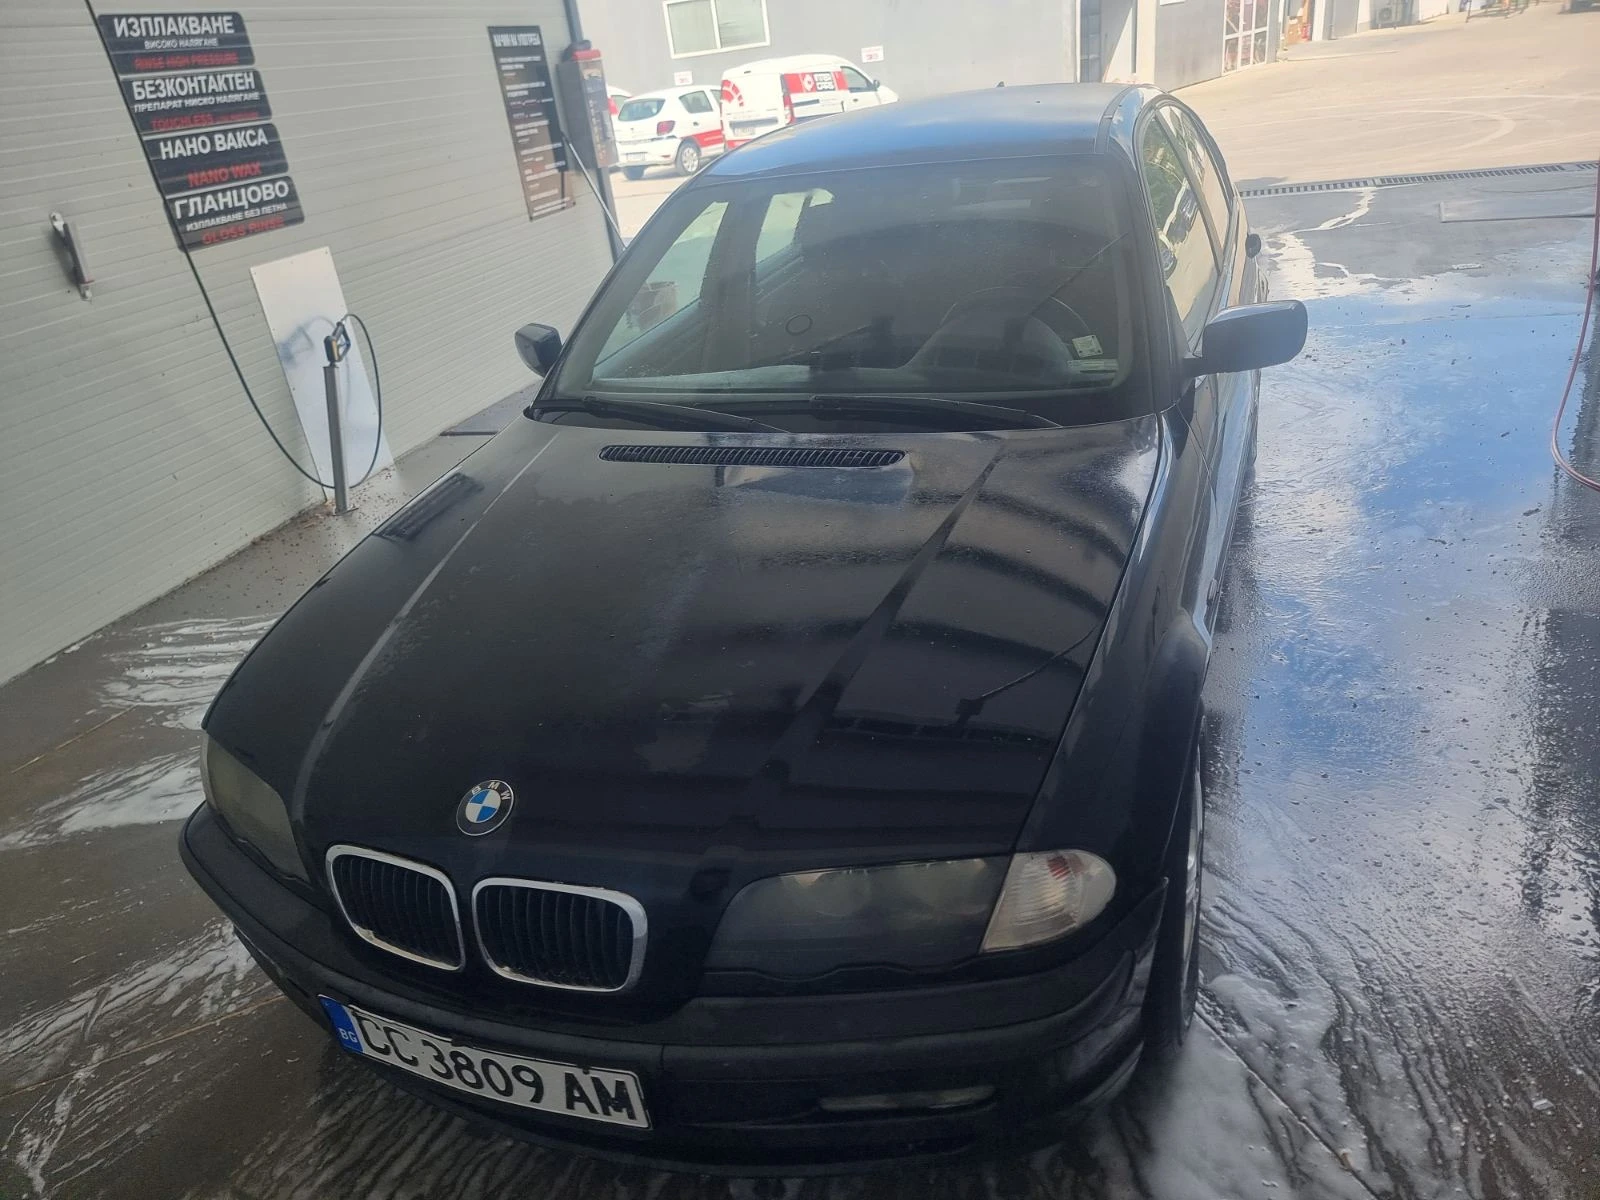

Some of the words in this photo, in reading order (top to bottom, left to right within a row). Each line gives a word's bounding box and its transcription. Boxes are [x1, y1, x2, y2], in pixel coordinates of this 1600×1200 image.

[113, 15, 235, 38] ИЗПЛАКВАНЕ
[144, 39, 178, 50] ВИСОКО
[132, 72, 255, 101] БЕЗКОНТАКТЕН
[133, 100, 183, 113] ПРЕПАРАТ
[184, 97, 215, 108] НИСКО
[160, 135, 211, 160] НАНО
[214, 128, 268, 152] ВАКСА
[187, 167, 229, 187] NANO
[230, 162, 261, 178] WAX
[174, 180, 289, 219] ГЛАНЦОВО
[186, 212, 243, 231] ИЗПЛАКВАНЕ
[244, 209, 261, 220] БЕЗ
[261, 203, 288, 214] ПЕТНА
[338, 1028, 359, 1043] BG
[422, 1040, 545, 1104] 3809
[564, 1072, 637, 1120] AM
